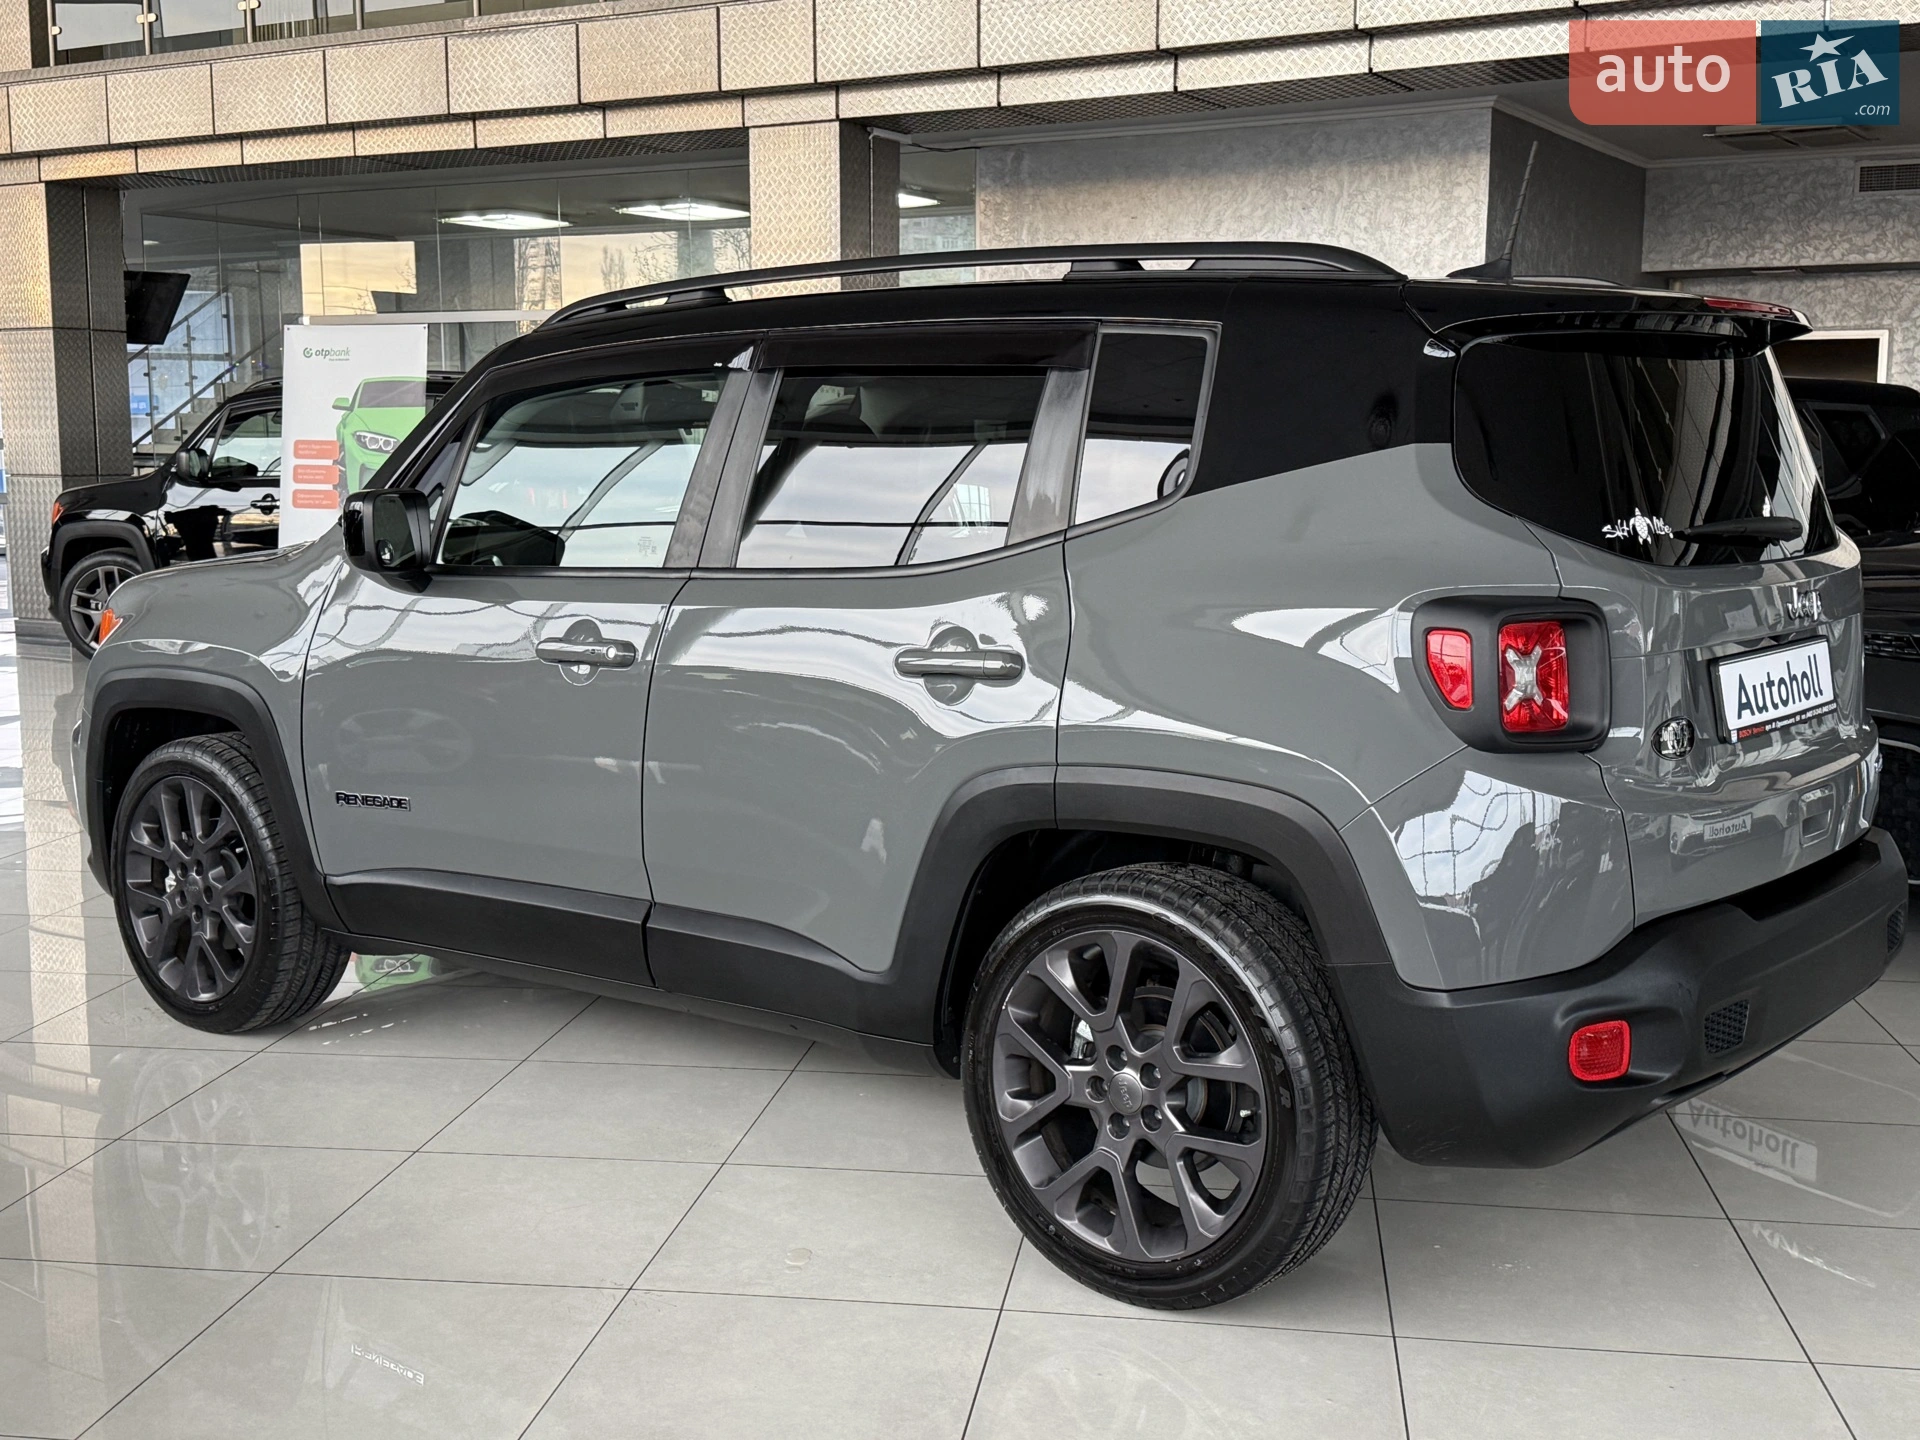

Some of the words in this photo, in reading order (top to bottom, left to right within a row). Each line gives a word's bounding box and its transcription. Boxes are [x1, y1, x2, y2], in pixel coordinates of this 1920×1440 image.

[1786, 586, 1822, 622] Jeep
[1737, 653, 1823, 720] Autoholl
[335, 791, 411, 811] RENEGADE
